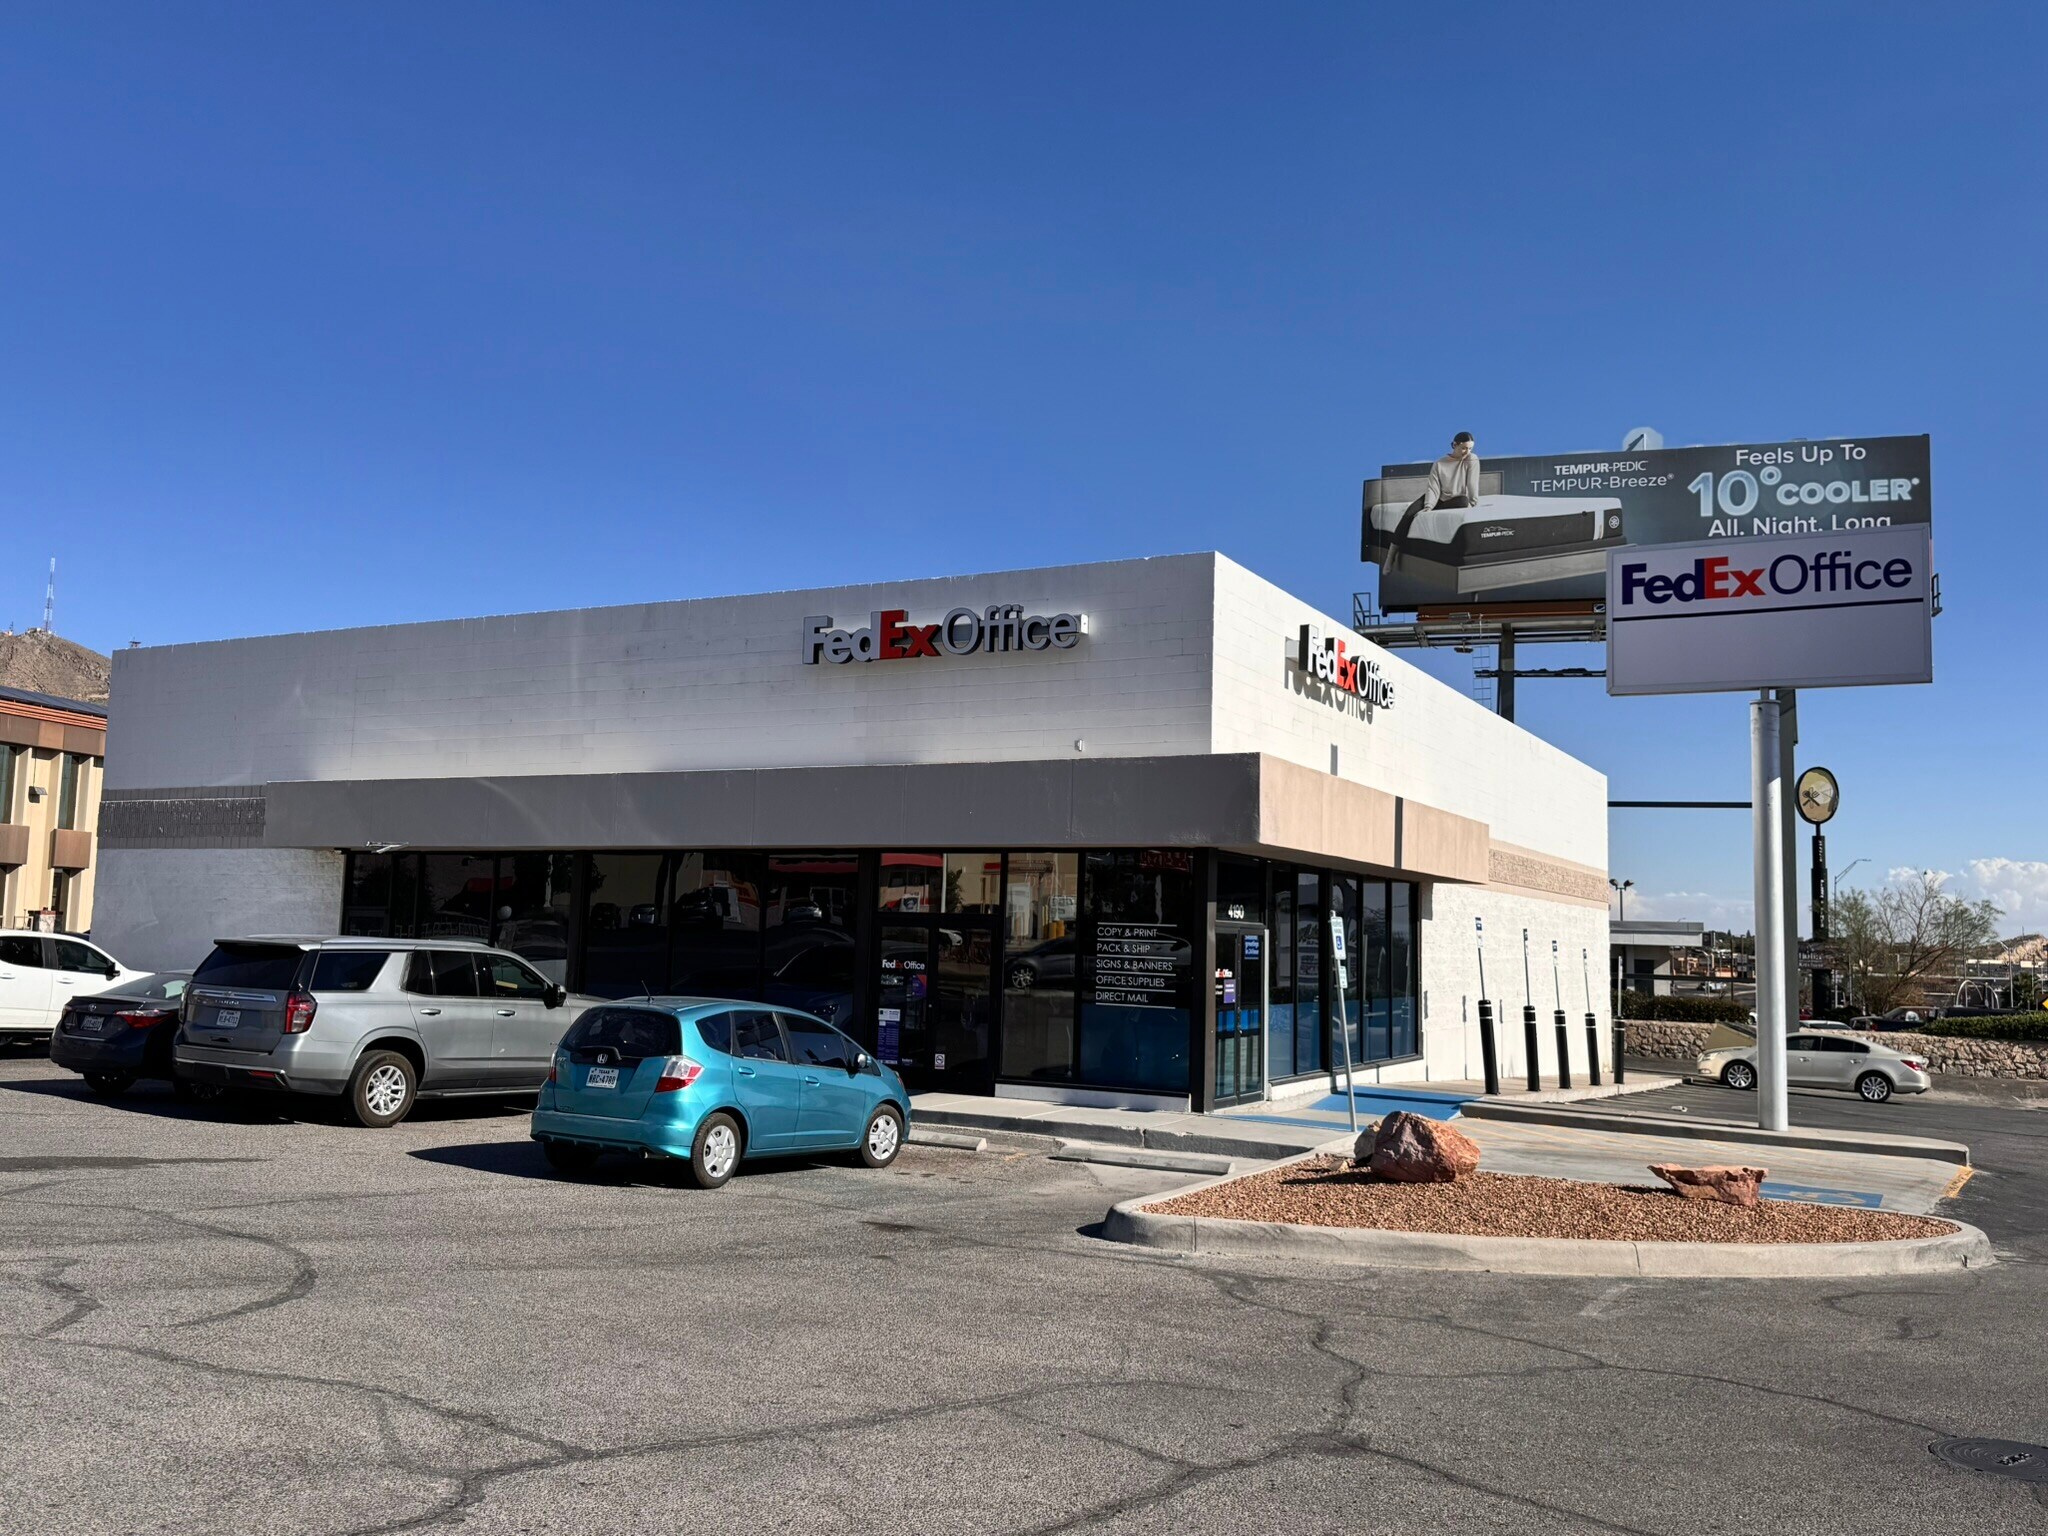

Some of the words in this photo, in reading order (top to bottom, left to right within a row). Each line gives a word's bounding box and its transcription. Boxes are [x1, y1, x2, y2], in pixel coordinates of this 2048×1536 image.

[1736, 447, 1795, 466] Feels
[1801, 446, 1834, 466] Up
[1840, 444, 1867, 461] To
[1621, 556, 1767, 605] FedEx
[1768, 550, 1913, 595] Office
[803, 609, 941, 664] FedEx
[942, 604, 1079, 655] Office
[1097, 927, 1122, 937] COPY
[1124, 928, 1132, 937] &
[1133, 928, 1158, 938] PRINT
[1096, 943, 1121, 953] PACK
[1123, 944, 1130, 953] &
[1131, 944, 1151, 954] SHIP
[903, 960, 925, 970] Office
[1096, 959, 1122, 969] SIGNS
[1123, 961, 1131, 970] &
[1132, 962, 1173, 971] BANNERS
[1096, 975, 1127, 986] OFFICE
[1128, 977, 1165, 987] SUPPLIES
[1096, 991, 1125, 1002] DIRECT
[1127, 993, 1149, 1003] MAIL
